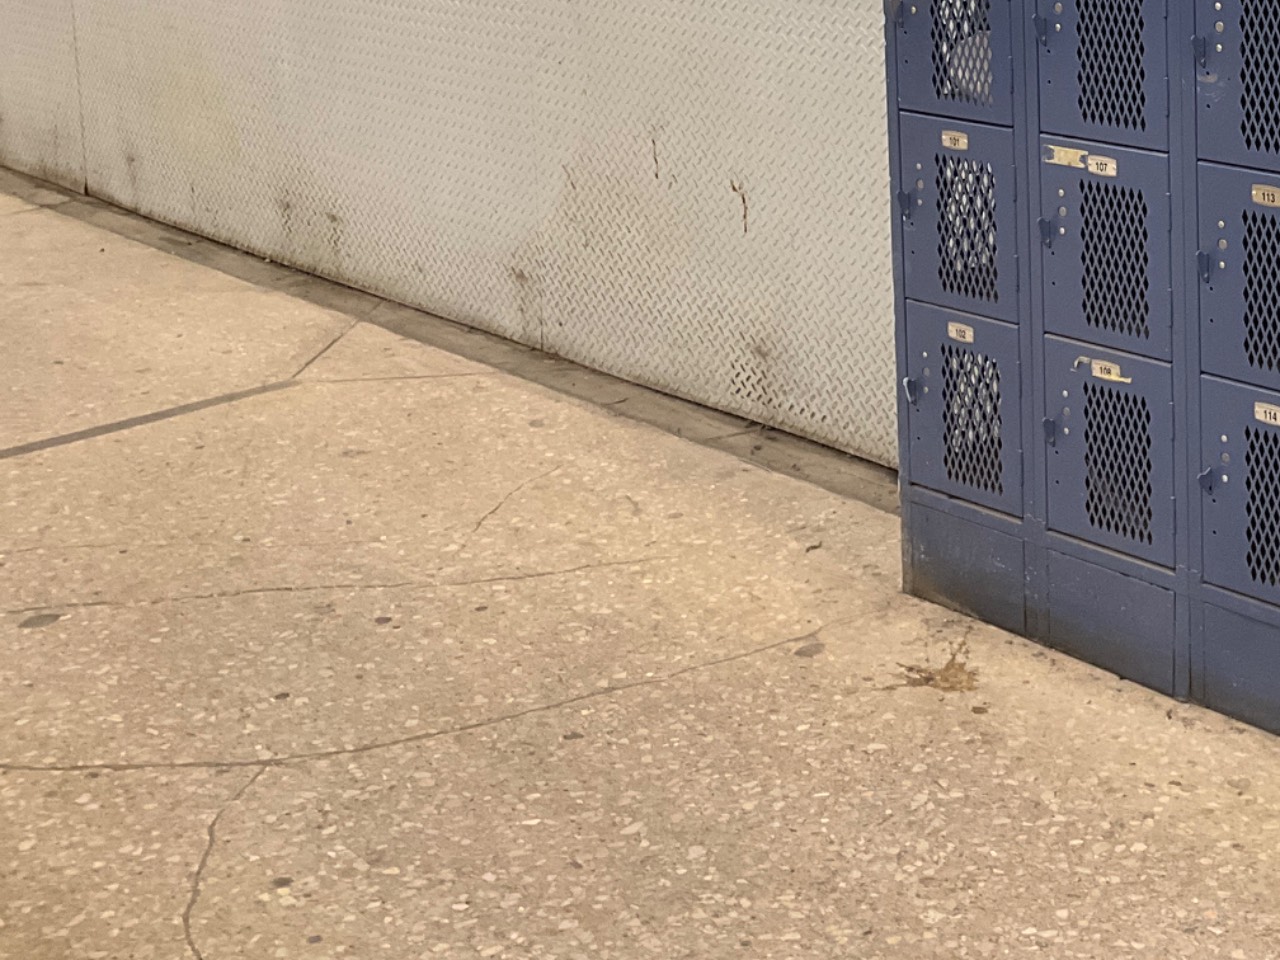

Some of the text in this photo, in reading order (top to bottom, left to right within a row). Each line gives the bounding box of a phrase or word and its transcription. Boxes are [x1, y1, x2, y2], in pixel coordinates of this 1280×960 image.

[949, 137, 960, 146] 101
[1095, 161, 1108, 172] 107
[1261, 191, 1276, 203] 113
[955, 328, 966, 339] 102
[1263, 410, 1277, 422] 114
